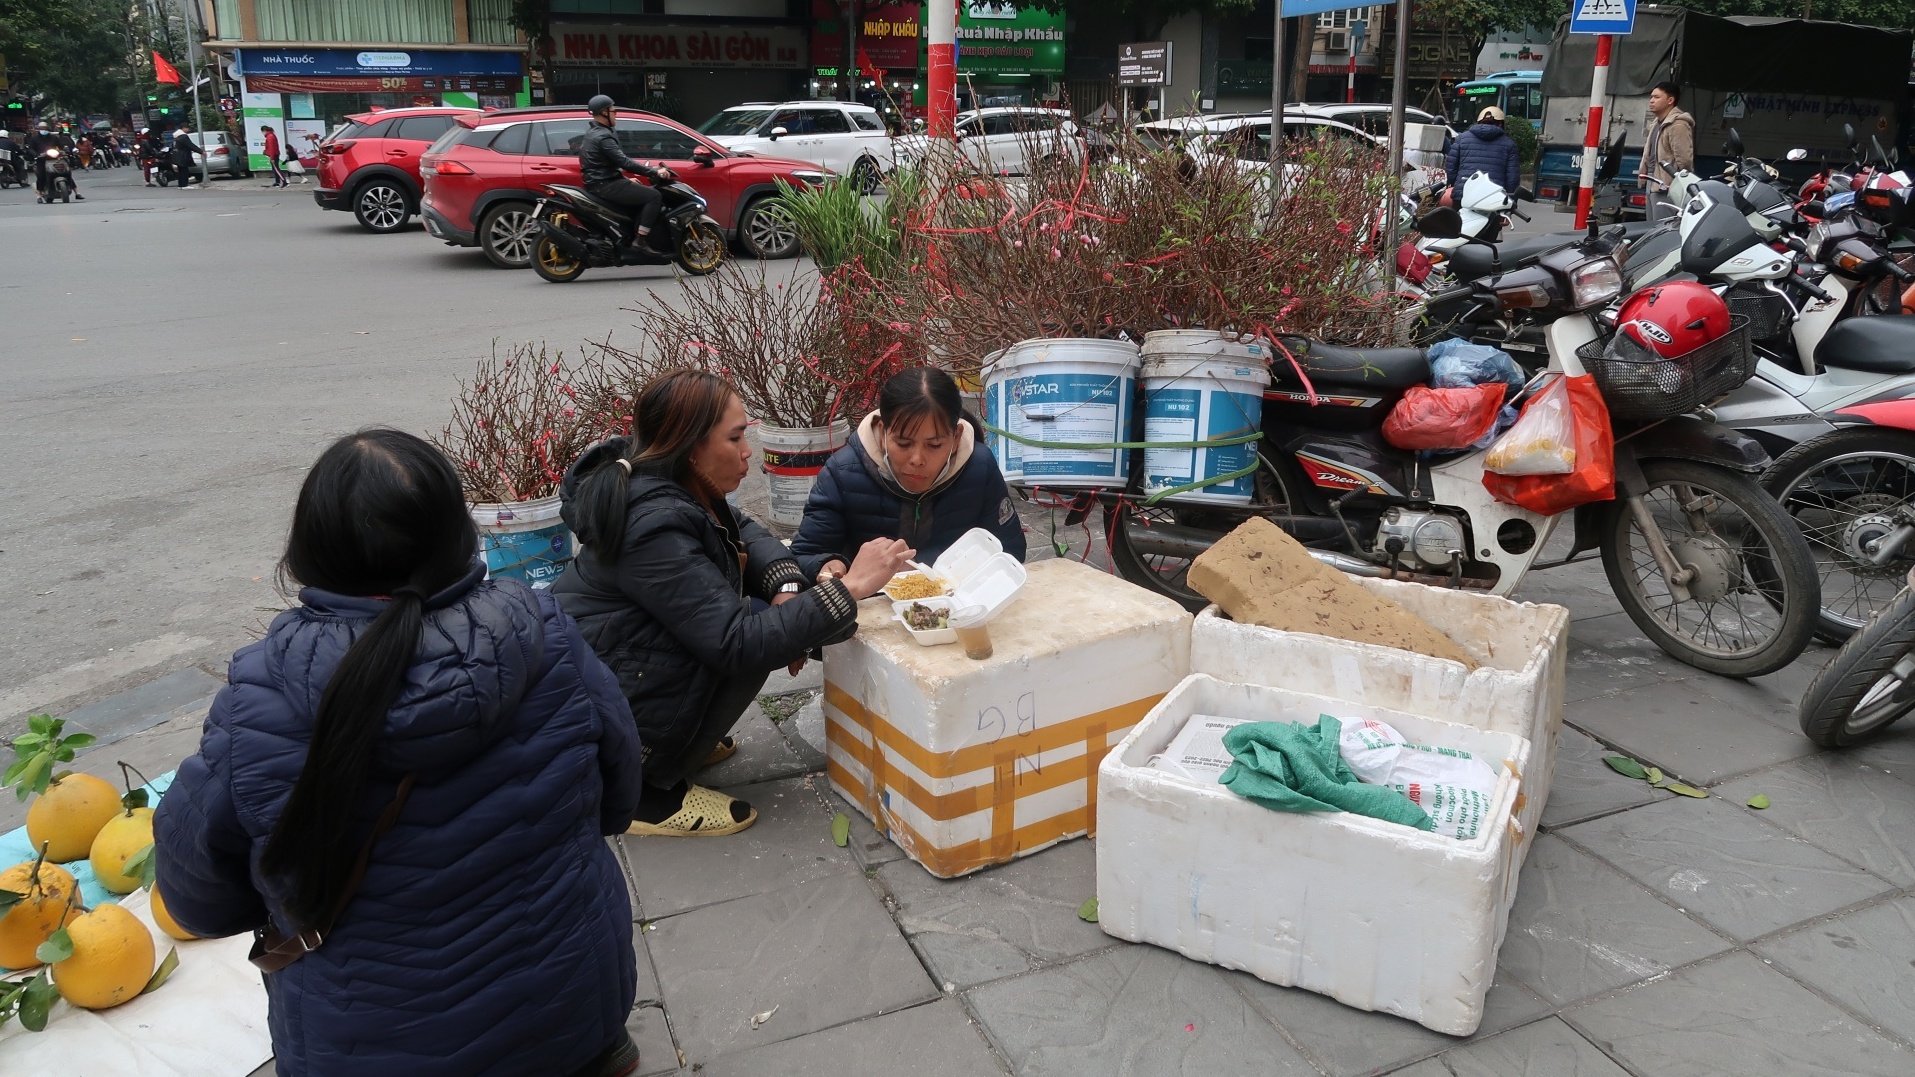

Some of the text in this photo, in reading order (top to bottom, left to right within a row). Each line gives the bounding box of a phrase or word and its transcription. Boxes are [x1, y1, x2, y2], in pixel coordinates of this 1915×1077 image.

[864, 18, 890, 40] NHẬP
[893, 17, 918, 37] KHẨU
[985, 27, 1022, 42] Nhập
[1025, 26, 1063, 41] Khẩu
[564, 34, 612, 59] NHA
[618, 35, 681, 60] KHOA
[687, 31, 721, 60] SÀI
[726, 31, 770, 61] GÒN
[263, 54, 315, 63] NHÀ THUỐC
[1316, 472, 1366, 485] Dream
[1438, 746, 1457, 758] MANG
[1460, 806, 1468, 824] pho
